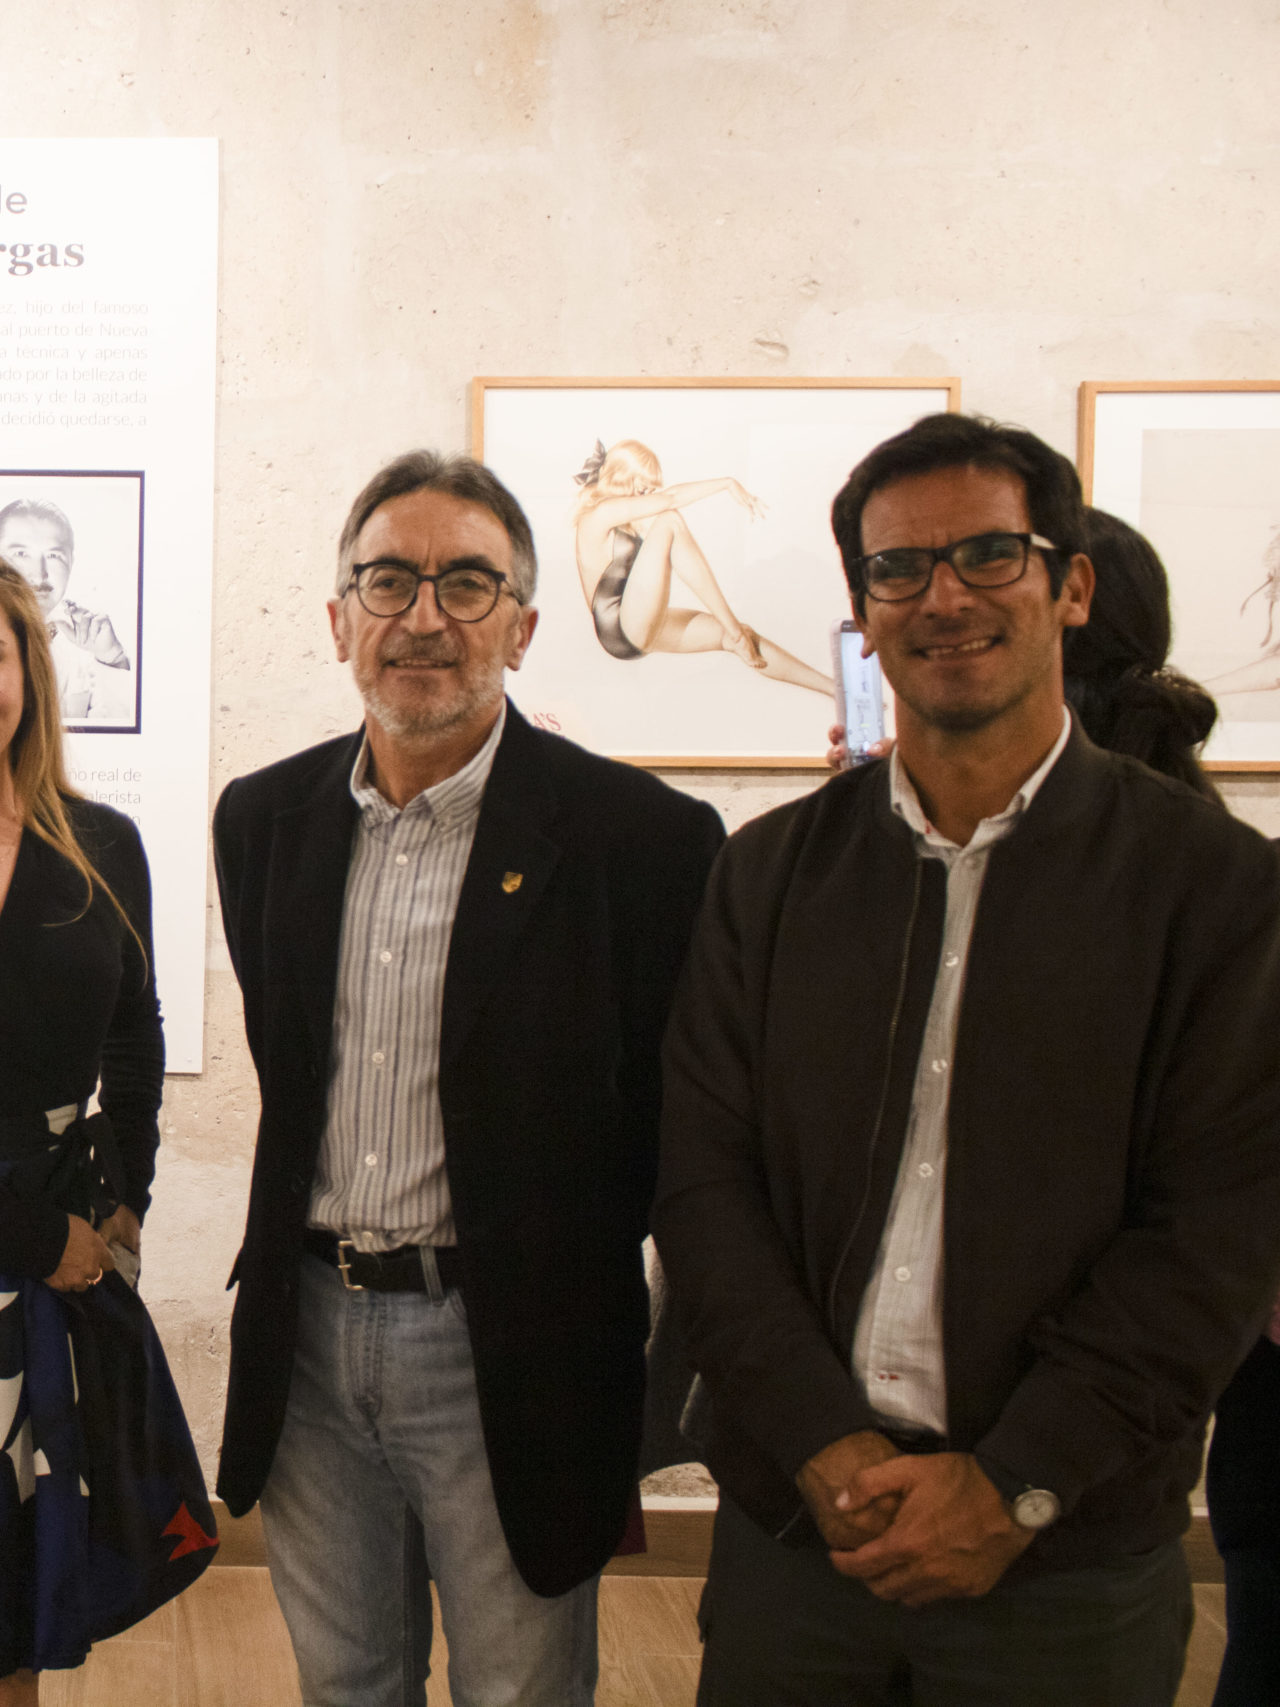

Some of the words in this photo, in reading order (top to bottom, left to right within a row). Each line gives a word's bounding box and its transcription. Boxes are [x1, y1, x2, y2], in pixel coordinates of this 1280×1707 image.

[25, 300, 53, 317] hijo
[61, 300, 84, 314] del
[93, 300, 149, 314] famoso
[0, 321, 12, 336] al
[18, 324, 69, 339] puerto
[74, 321, 93, 336] de
[99, 323, 148, 336] Nueva
[16, 344, 69, 359] técnica
[78, 348, 87, 360] y
[95, 347, 148, 361] apenas
[26, 370, 50, 384] por
[56, 367, 68, 381] la
[72, 367, 124, 381] belleza
[129, 368, 147, 381] de
[34, 392, 43, 405] y
[48, 390, 68, 403] de
[74, 389, 86, 403] la
[92, 390, 147, 406] agitada
[1, 411, 55, 425] decidió
[138, 414, 147, 425] a
[92, 768, 118, 781] real
[123, 768, 141, 781] de
